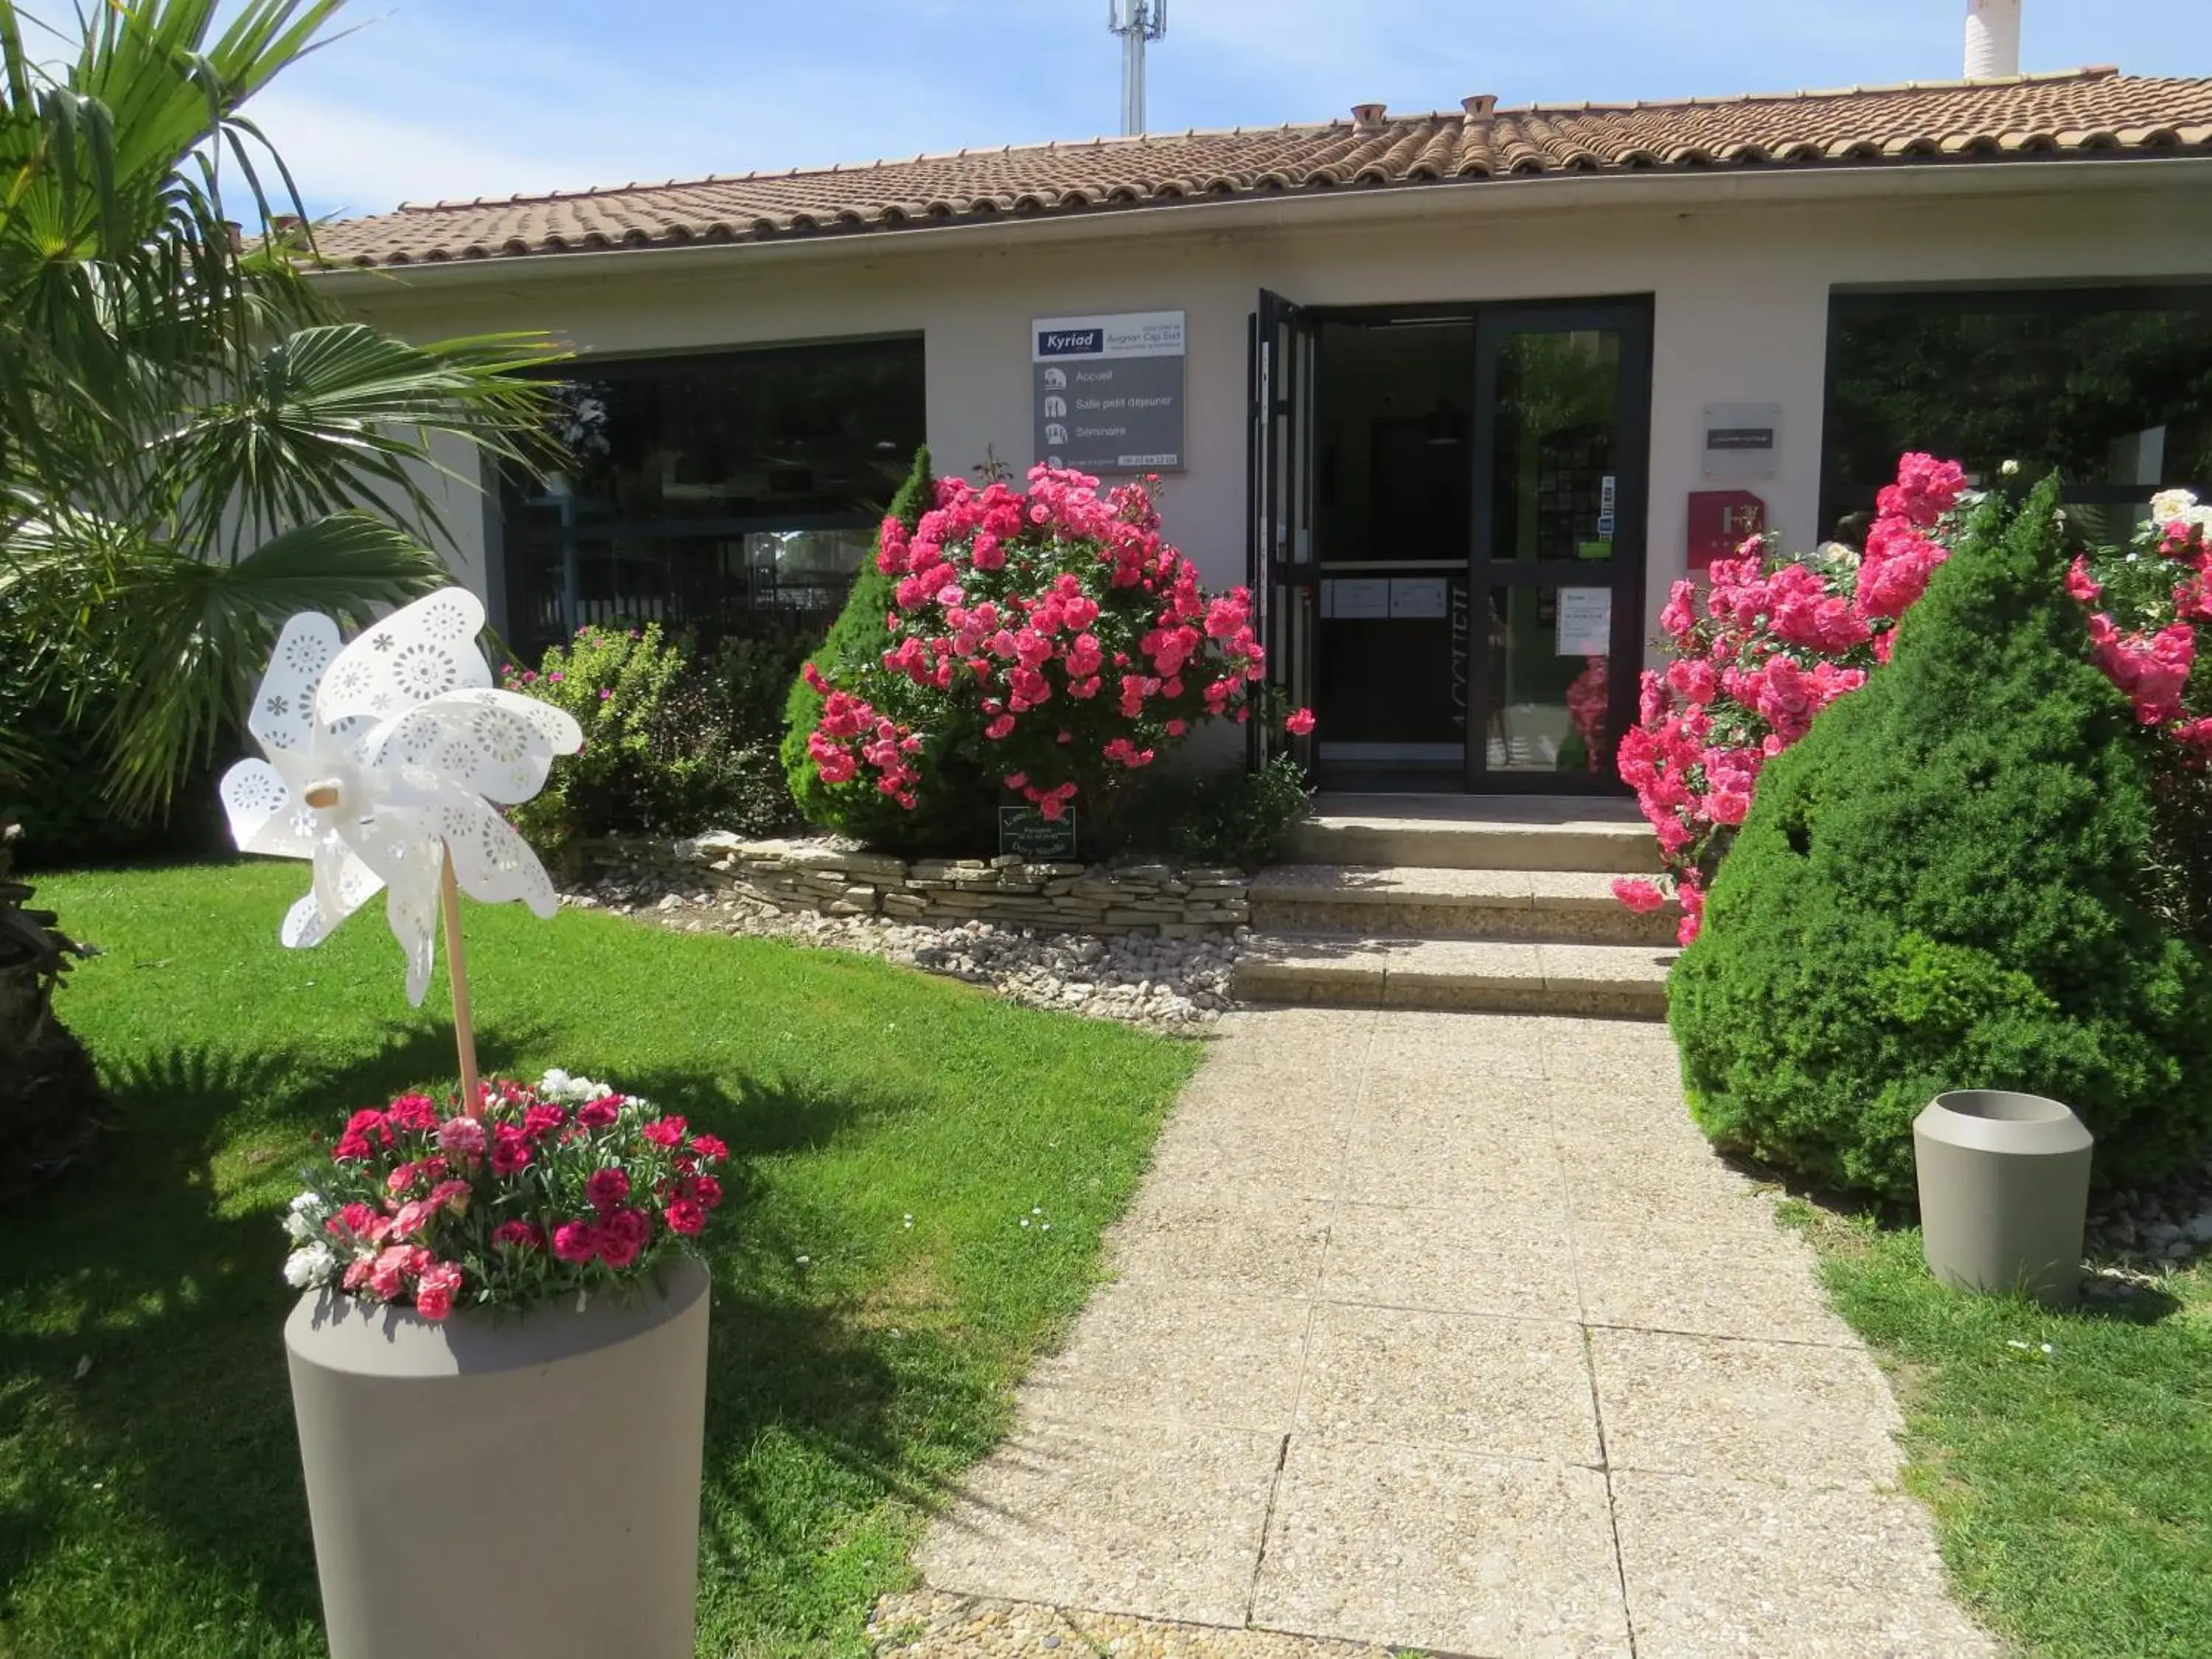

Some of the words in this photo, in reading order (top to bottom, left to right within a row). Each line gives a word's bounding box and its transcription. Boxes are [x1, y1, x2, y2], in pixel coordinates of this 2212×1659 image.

[1047, 333, 1093, 350] Kyriad
[1144, 332, 1161, 342] Cap
[1163, 330, 1180, 340] Sud
[1075, 369, 1113, 381] Accueil
[1076, 399, 1101, 410] Salle
[1102, 397, 1126, 411] petit
